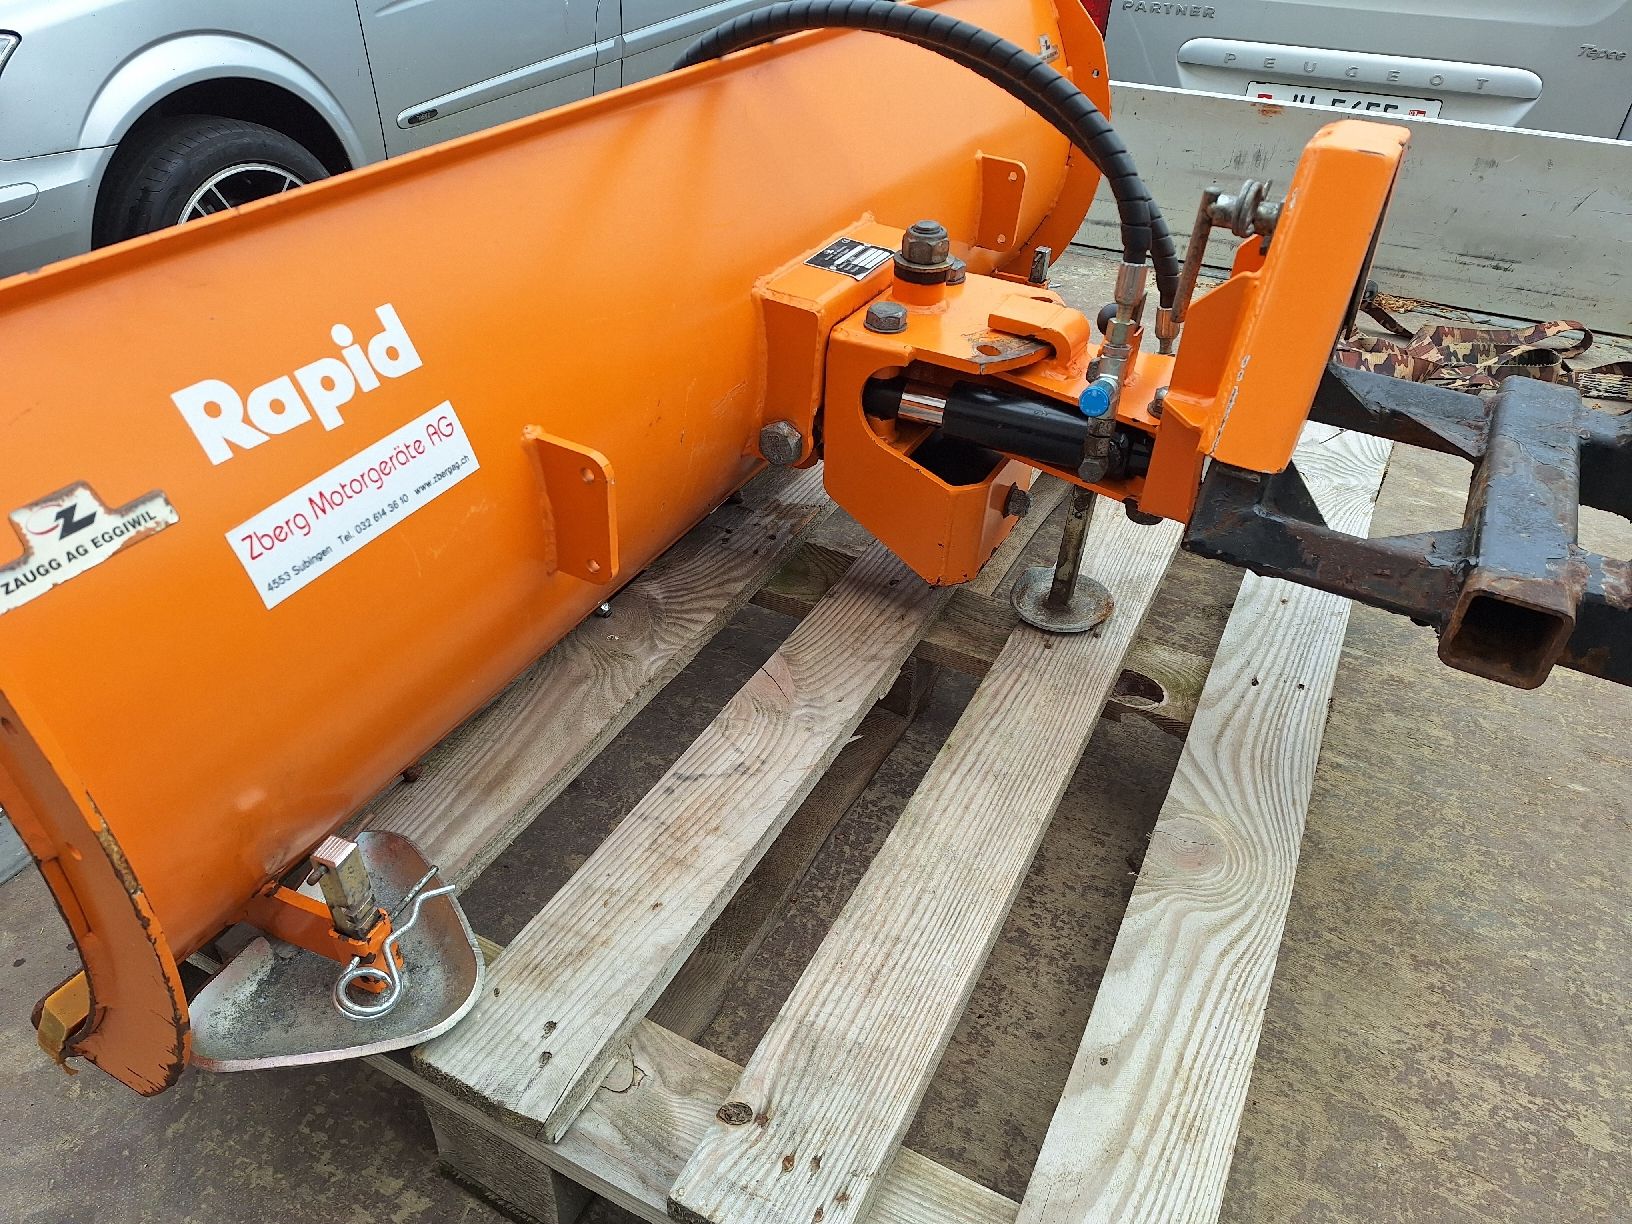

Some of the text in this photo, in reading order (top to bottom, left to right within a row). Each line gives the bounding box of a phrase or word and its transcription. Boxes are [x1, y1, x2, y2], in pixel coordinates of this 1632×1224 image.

[1122, 0, 1216, 19] PARTNER
[1577, 43, 1627, 61] Tepee
[1224, 52, 1489, 90] PEUGEOT
[170, 303, 423, 466] Rapid
[241, 415, 454, 561] Zberg Motorgeräte AG
[266, 454, 471, 592] 4553 Subingen Tel. 032 614 36 10 www.zbergag.ch
[0, 511, 157, 596] ZAUGG AG EGGIWIL
